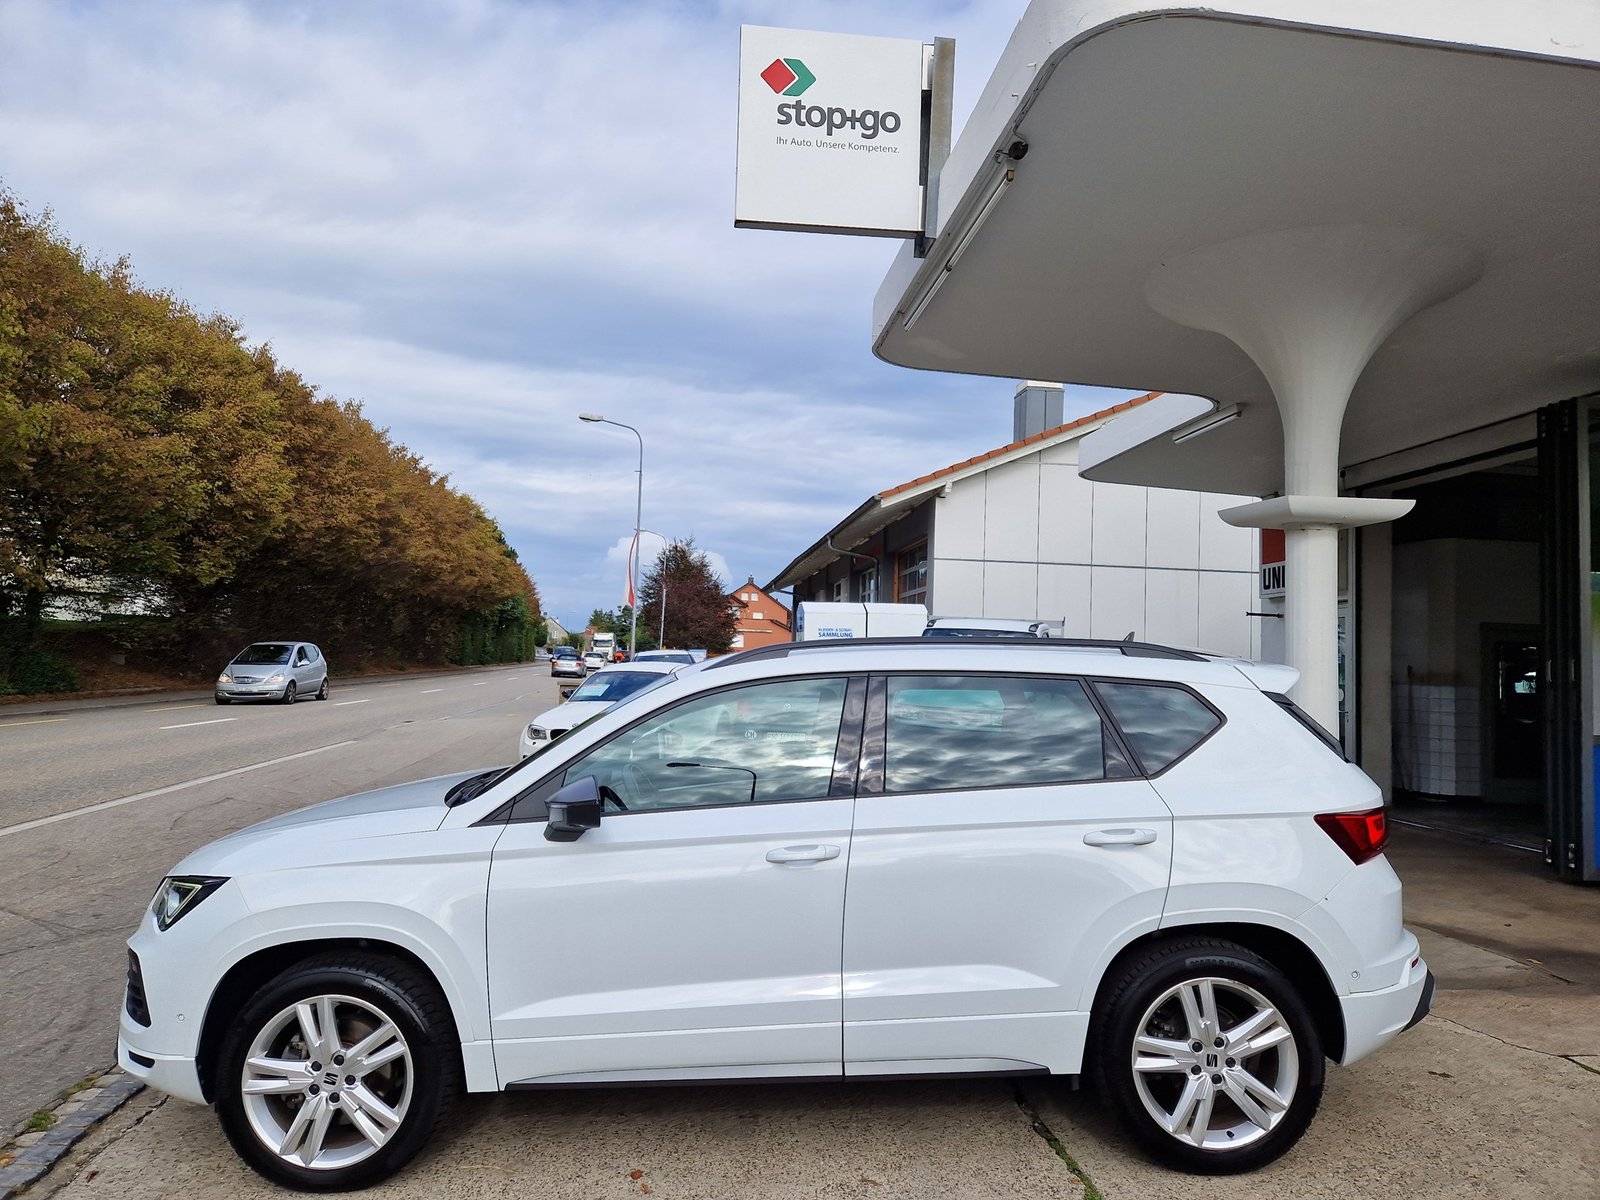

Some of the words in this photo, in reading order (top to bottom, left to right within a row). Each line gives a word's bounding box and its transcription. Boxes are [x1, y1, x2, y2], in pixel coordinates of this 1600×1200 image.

[777, 99, 901, 139] stop+go
[776, 136, 788, 145] Ihr
[790, 137, 813, 147] Auto.
[815, 140, 846, 150] Unsere
[848, 142, 900, 154] Kompetenz.
[1263, 565, 1285, 590] UNI
